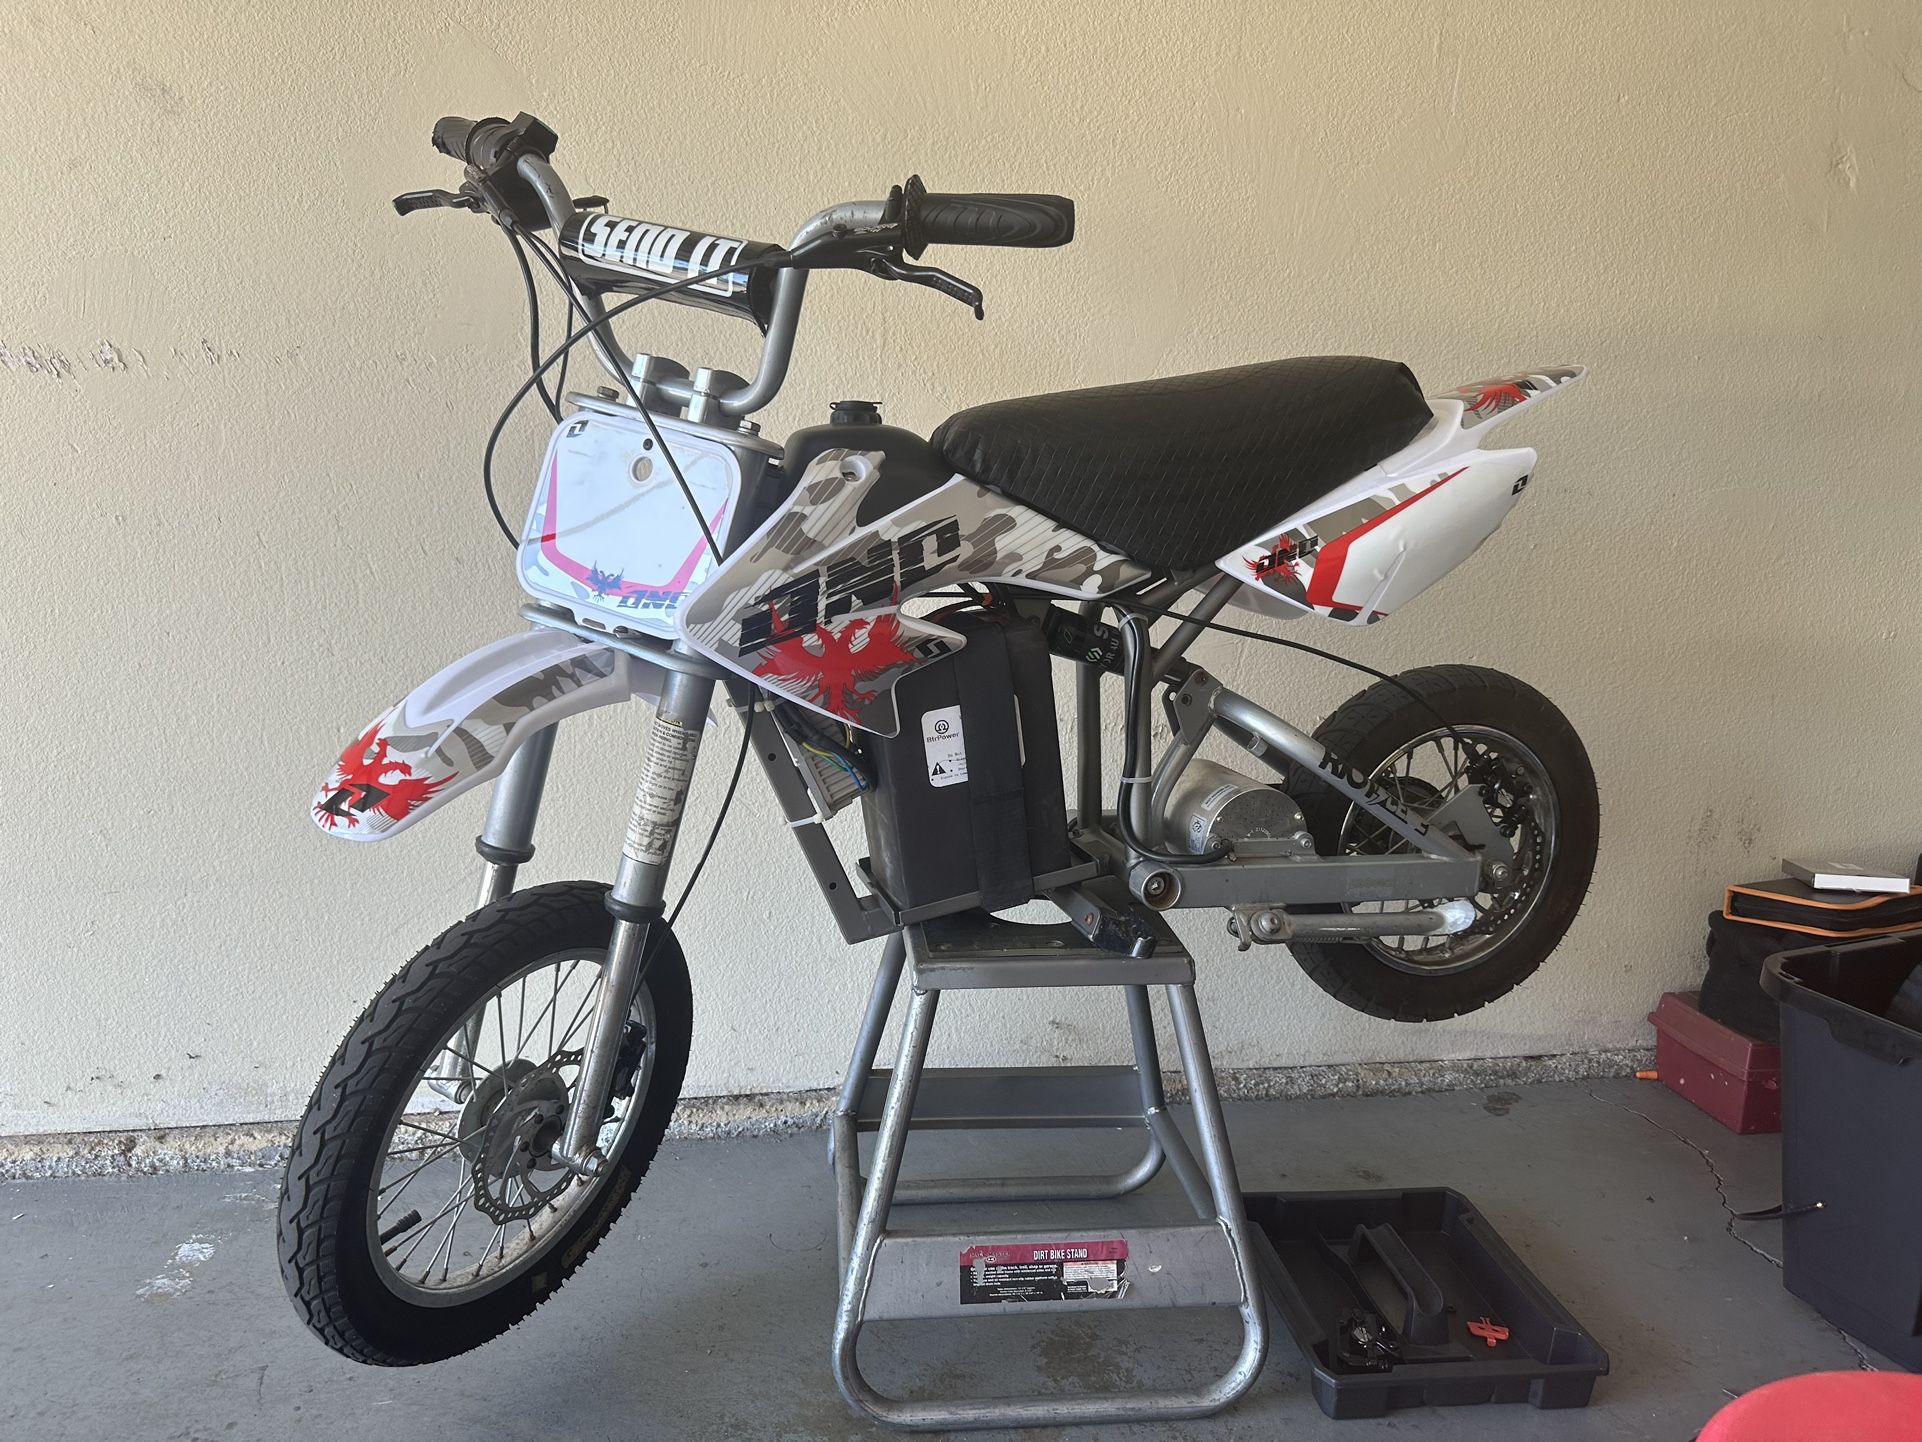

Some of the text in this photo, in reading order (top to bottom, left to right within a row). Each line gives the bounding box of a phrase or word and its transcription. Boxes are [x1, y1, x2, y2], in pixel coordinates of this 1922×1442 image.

[687, 235, 741, 284] IT
[1033, 1248, 1088, 1261] DIRT BIKE STAND
